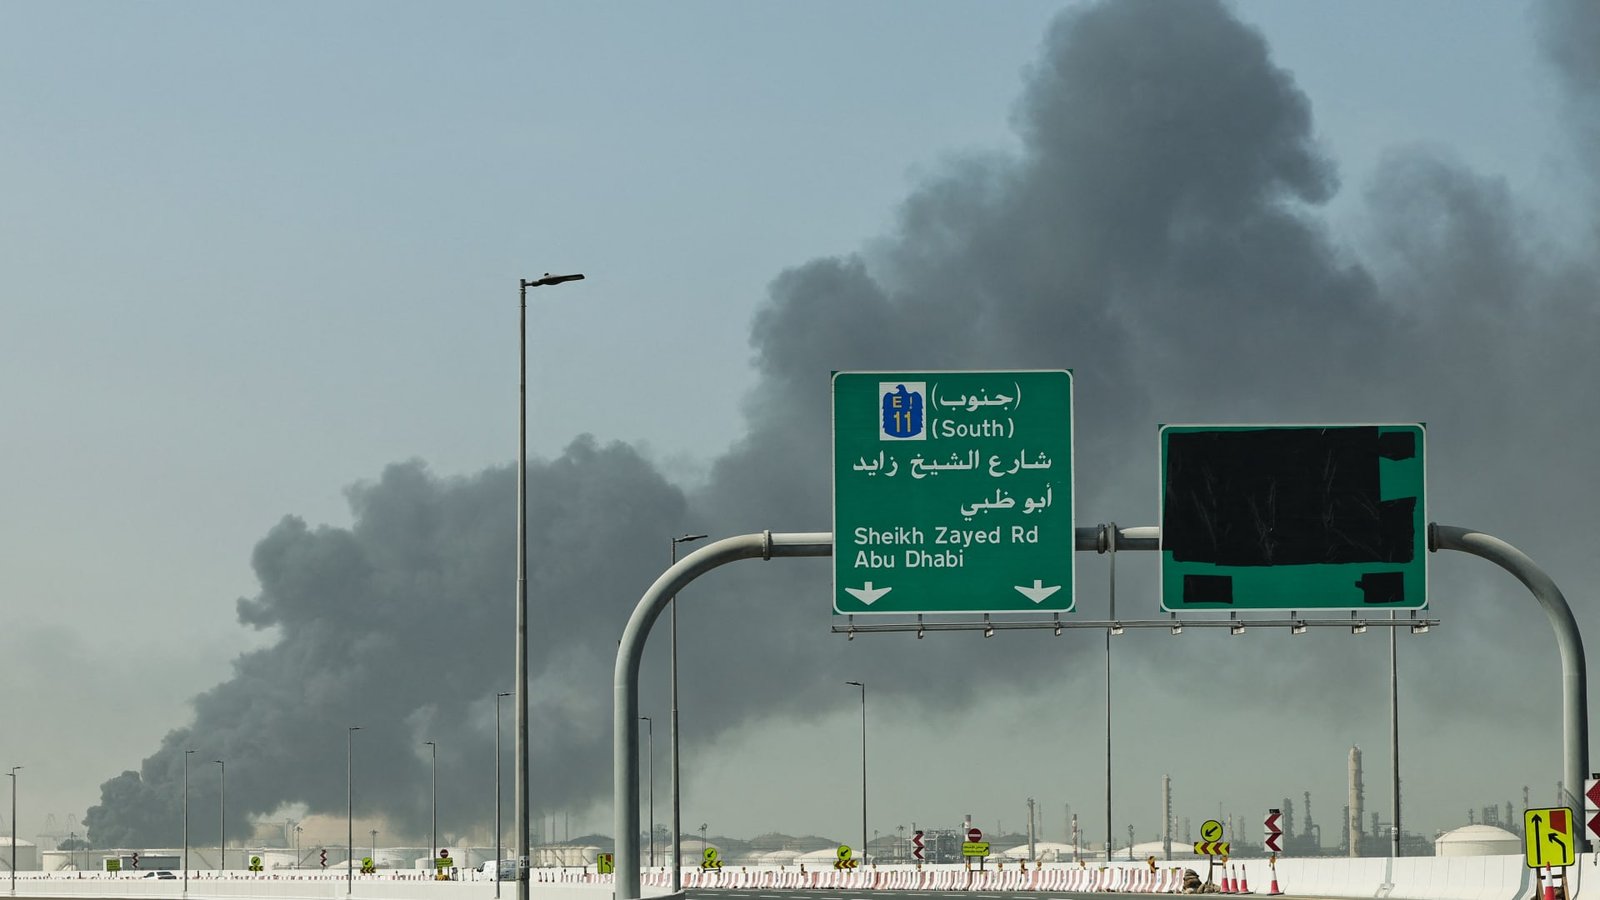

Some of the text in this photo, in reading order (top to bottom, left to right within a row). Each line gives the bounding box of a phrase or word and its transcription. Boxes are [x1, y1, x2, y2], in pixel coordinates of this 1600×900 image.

[892, 395, 902, 409] E
[931, 382, 1022, 412] (جنوب)
[893, 410, 912, 433] 11
[931, 417, 1014, 439] (South)
[852, 448, 1052, 479] شارع الشيخ زايد
[960, 482, 1053, 522] أبو ظبي
[854, 525, 1039, 548] Sheikh Zayed Rd
[854, 550, 964, 569] Abu Dhabi
